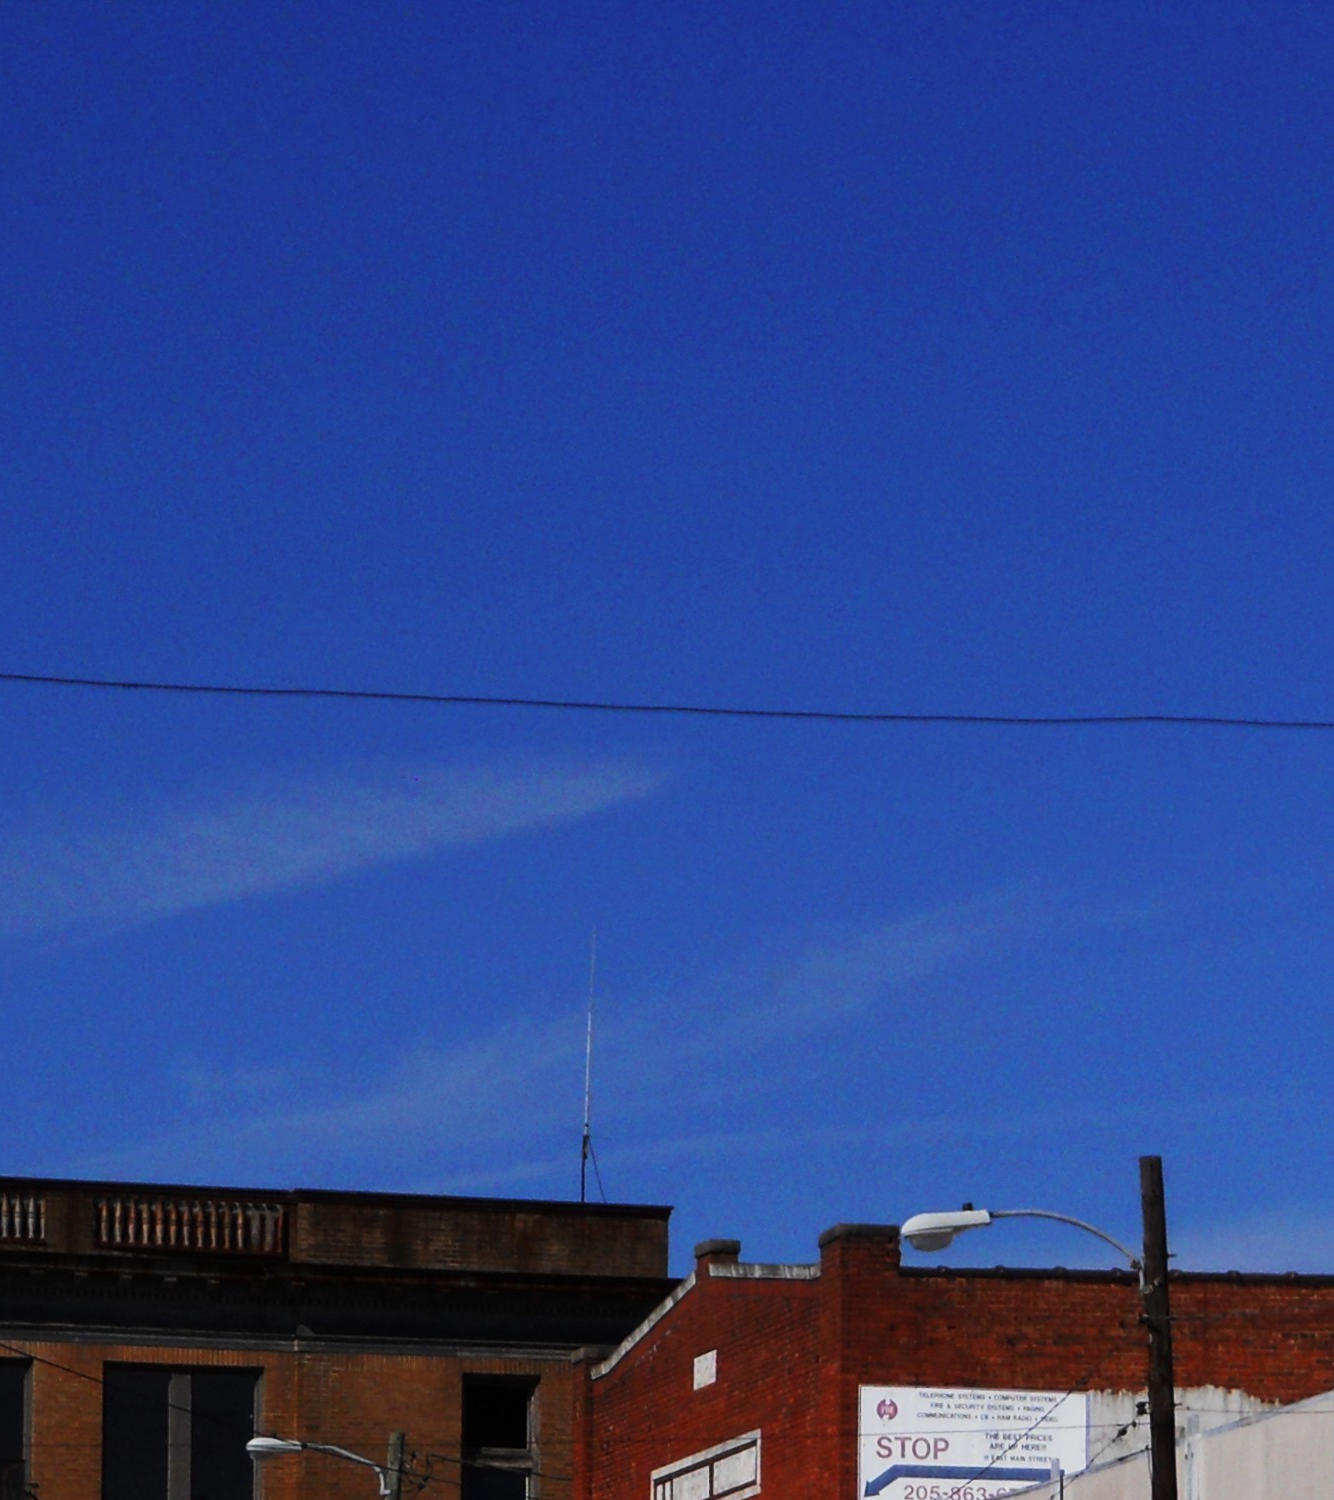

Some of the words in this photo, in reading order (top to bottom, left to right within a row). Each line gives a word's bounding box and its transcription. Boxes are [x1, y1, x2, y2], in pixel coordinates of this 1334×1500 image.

[918, 1391, 954, 1399] TELEPHONE
[993, 1394, 1028, 1402] COMPUTER
[984, 1432, 1000, 1440] THE
[1002, 1433, 1022, 1441] BEST
[1025, 1434, 1053, 1442] PRICES
[875, 1436, 950, 1460] STOP
[989, 1442, 1004, 1450] ARE
